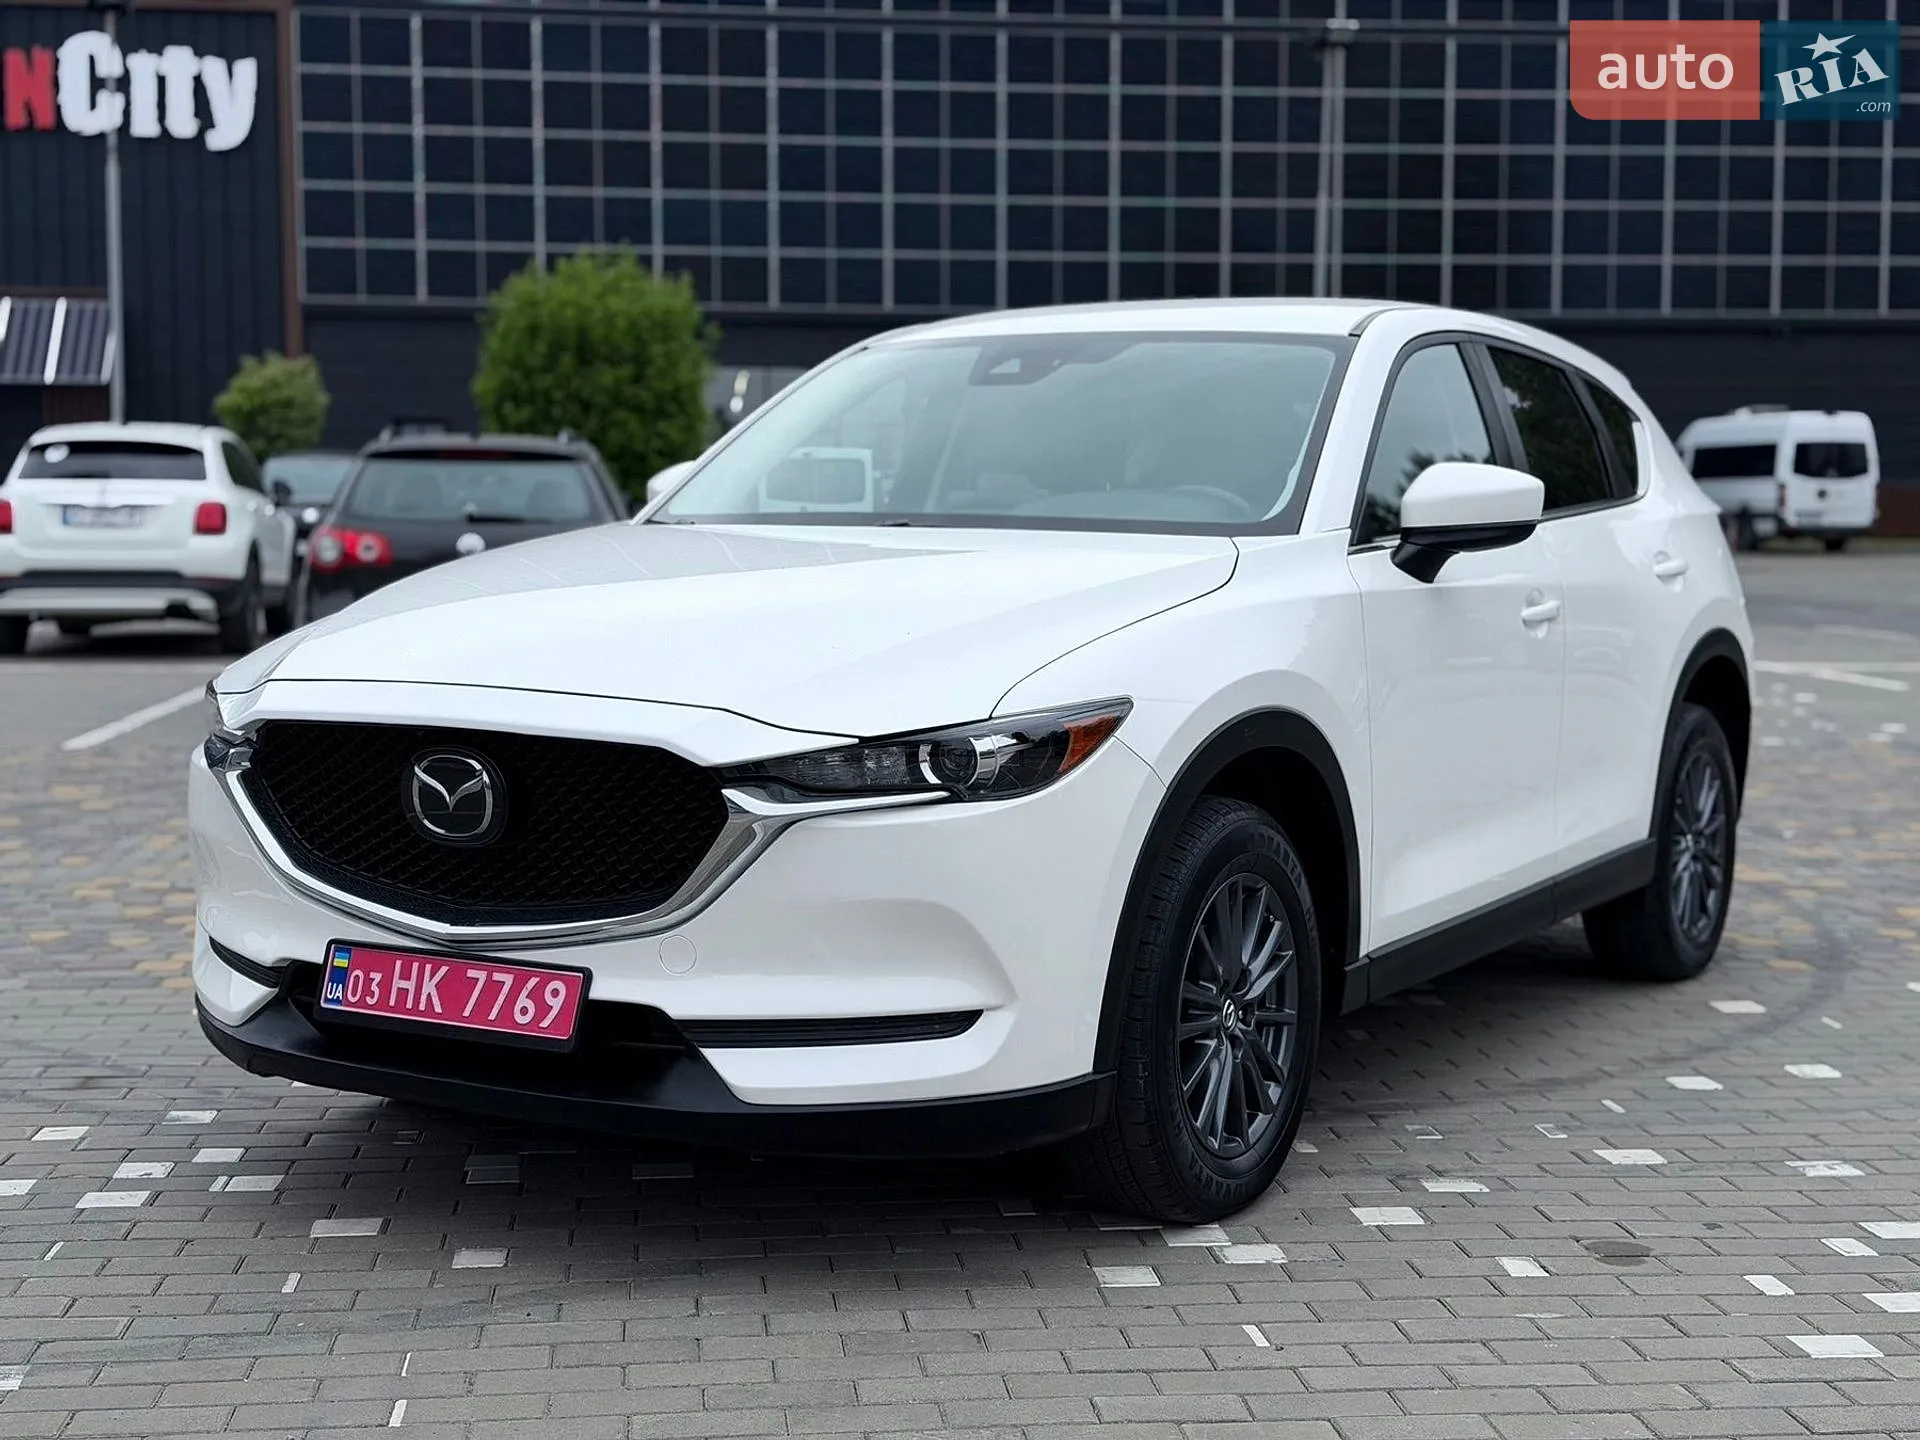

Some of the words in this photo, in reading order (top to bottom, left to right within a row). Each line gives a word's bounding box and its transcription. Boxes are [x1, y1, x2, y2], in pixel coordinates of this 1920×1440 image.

[326, 982, 344, 1001] UA
[346, 968, 384, 1006] 03
[388, 959, 450, 1014] HK
[462, 968, 567, 1029] 7769
